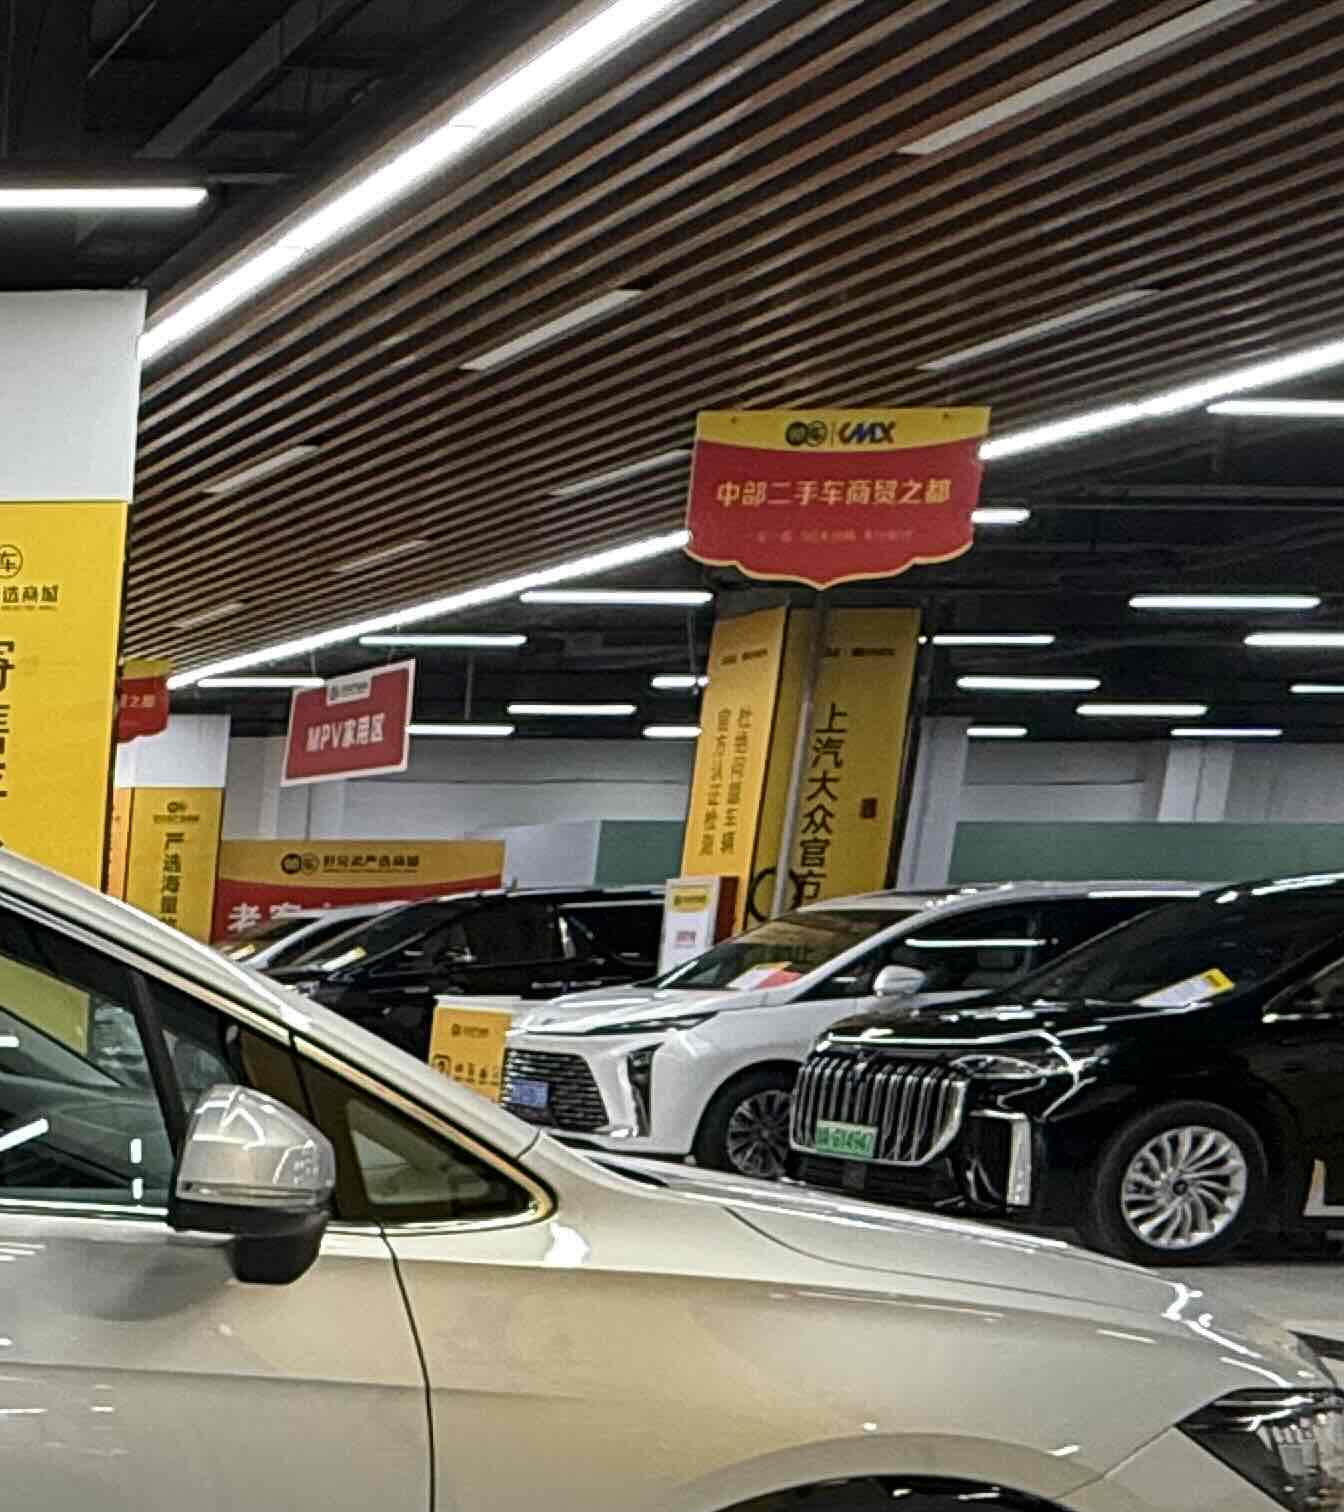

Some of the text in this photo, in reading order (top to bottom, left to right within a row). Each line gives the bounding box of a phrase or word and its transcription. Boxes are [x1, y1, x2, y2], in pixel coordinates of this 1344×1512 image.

[716, 478, 952, 507] 中部二手车商贸之都
[797, 701, 848, 901] 上汽大众官方
